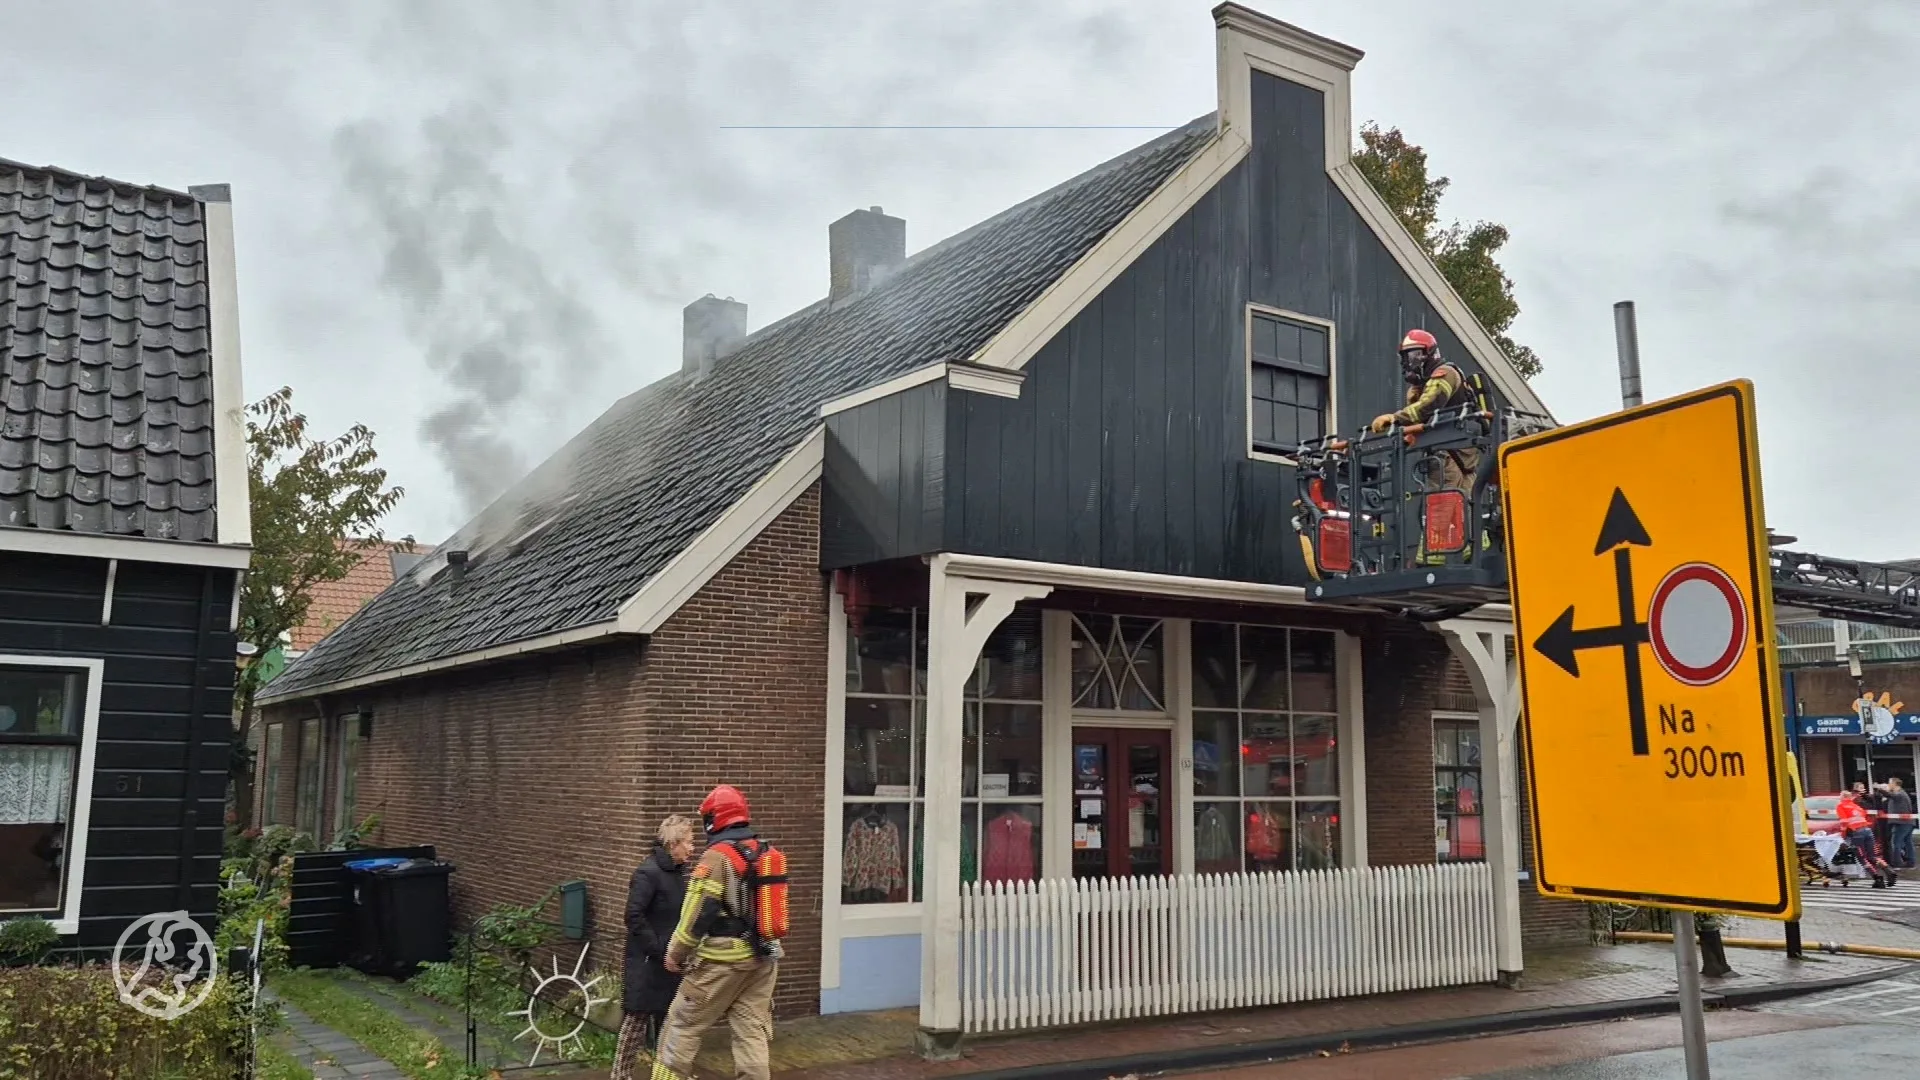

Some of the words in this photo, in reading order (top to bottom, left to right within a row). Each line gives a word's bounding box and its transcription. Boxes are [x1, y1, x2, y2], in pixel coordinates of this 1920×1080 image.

[1659, 703, 1696, 735] Na
[1816, 717, 1850, 727] Gazelle
[1663, 745, 1745, 779] 300m
[116, 774, 142, 793] 51
